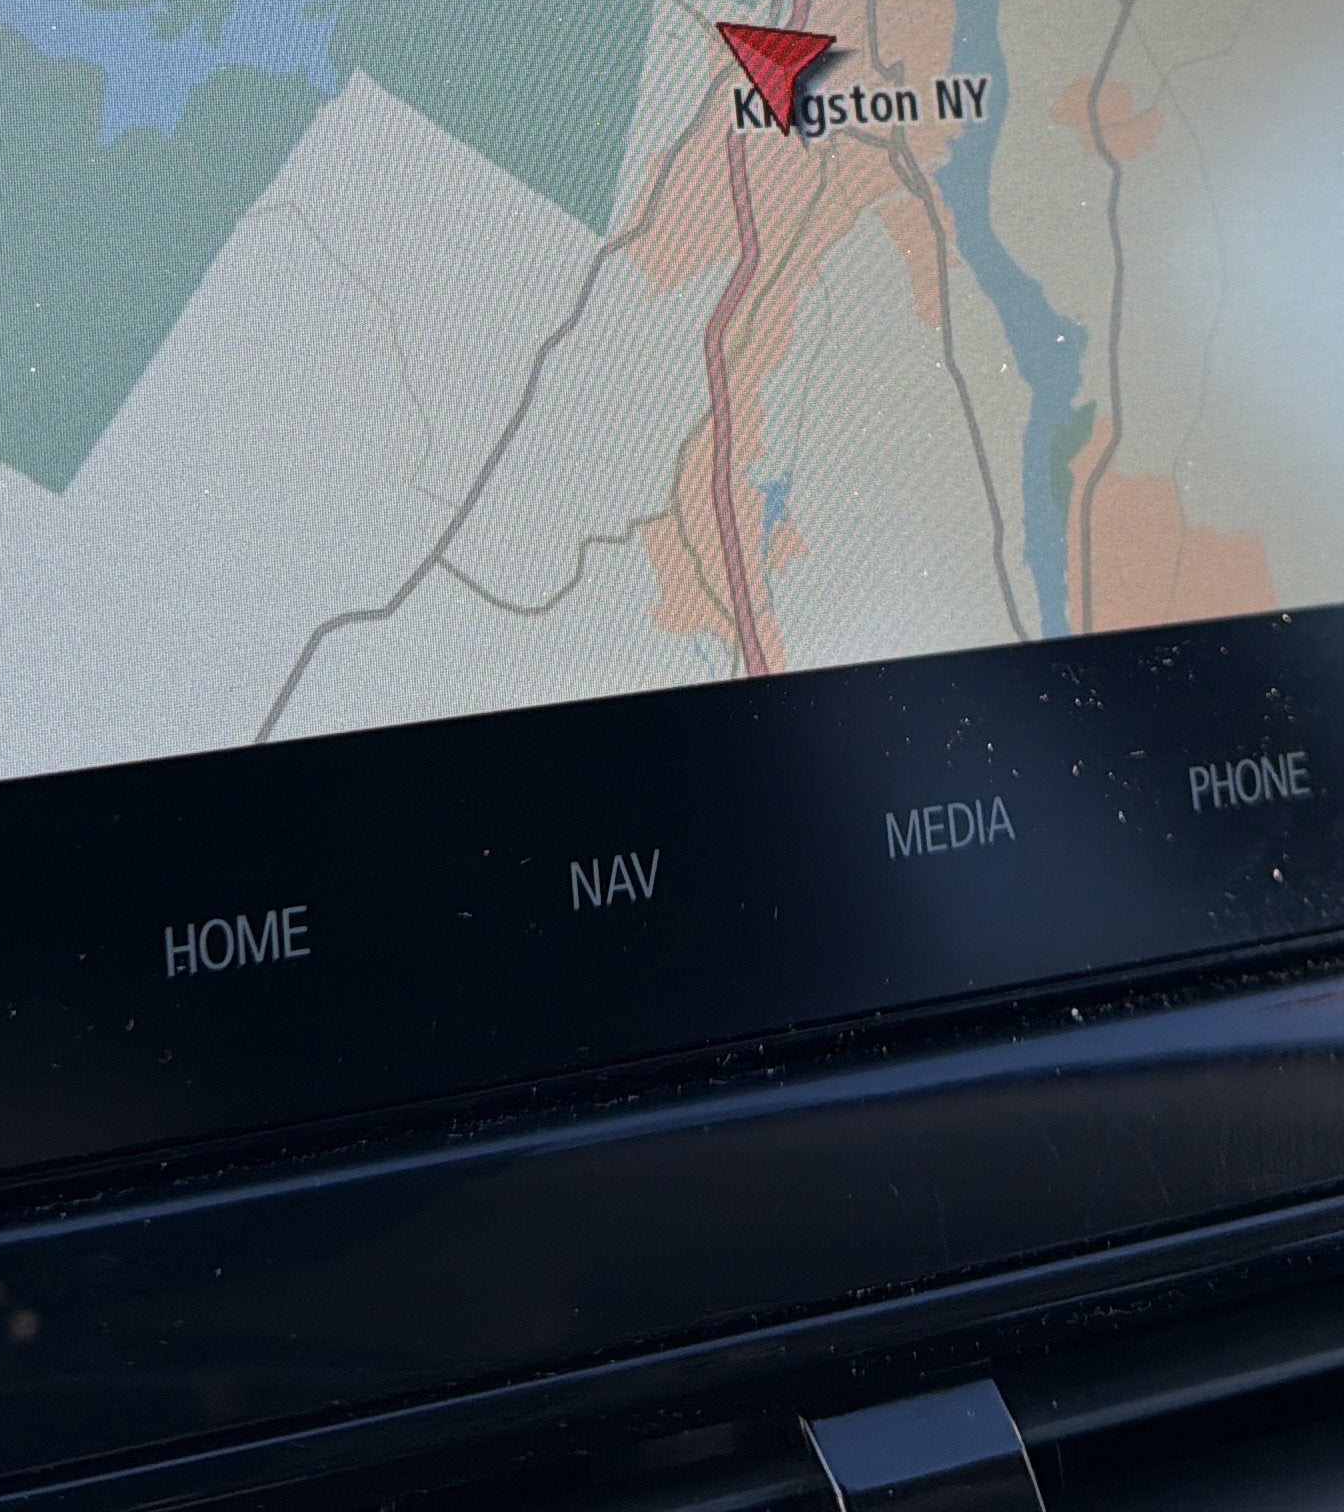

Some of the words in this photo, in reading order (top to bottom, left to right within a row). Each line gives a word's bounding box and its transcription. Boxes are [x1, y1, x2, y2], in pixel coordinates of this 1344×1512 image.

[935, 77, 988, 120] NY
[1188, 750, 1311, 811] PHONE
[885, 795, 1016, 859] MEDIA
[570, 848, 660, 912] NAV
[164, 905, 311, 977] HOME
